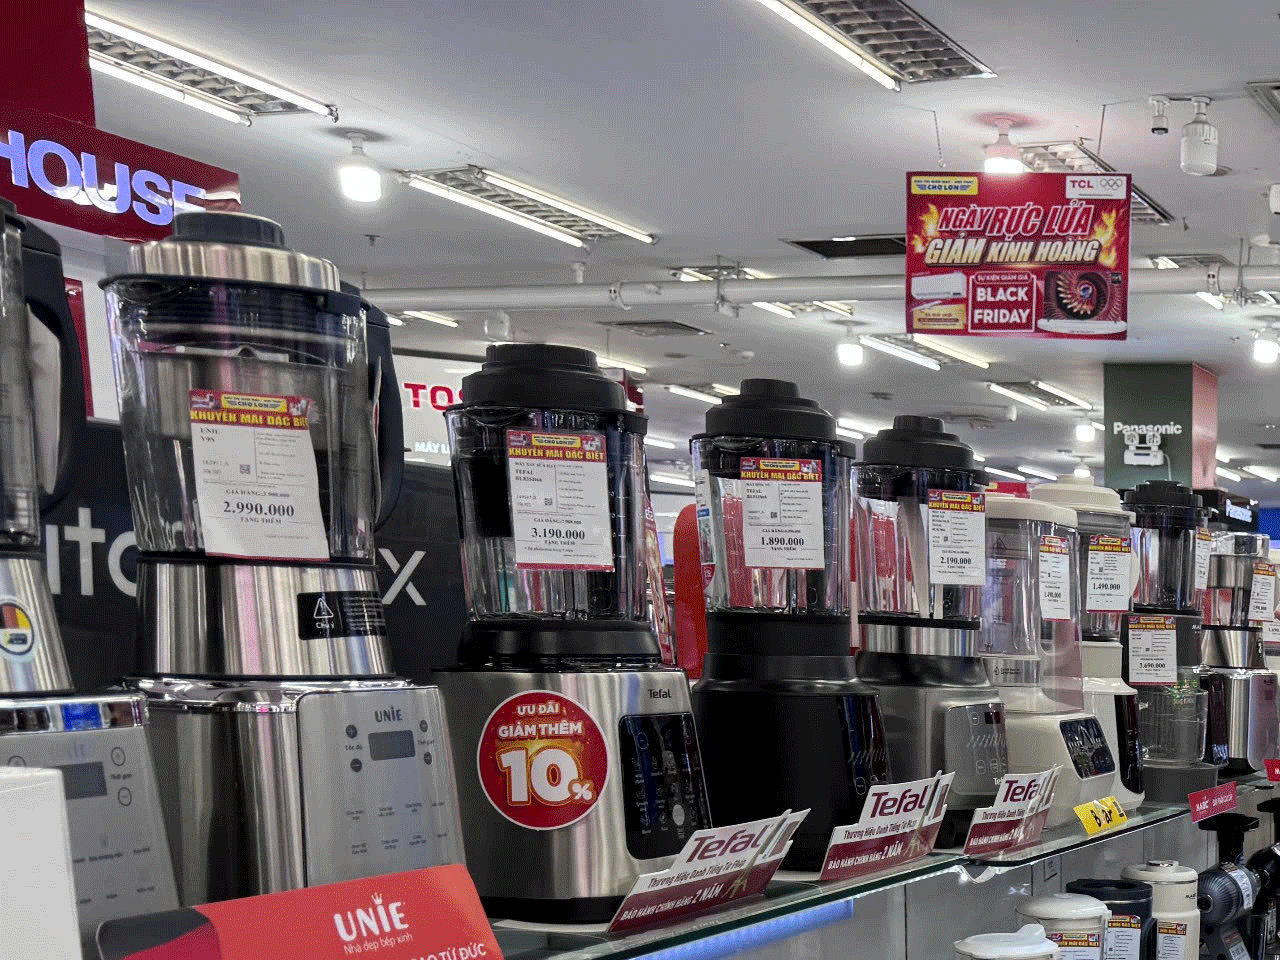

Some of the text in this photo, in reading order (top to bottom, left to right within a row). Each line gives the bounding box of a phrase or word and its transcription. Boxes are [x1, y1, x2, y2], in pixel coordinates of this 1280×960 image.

[1070, 180, 1093, 189] TCL
[938, 199, 1095, 241] NGÀY RỰC LỬA
[924, 233, 1101, 265] GIẢM KINH HOÀNG
[976, 287, 1029, 302] BLACK
[973, 309, 1030, 324] FRIDAY
[1113, 421, 1182, 437] Panasonic
[223, 501, 295, 516] 2.990.000
[531, 528, 585, 540] 3.190.000
[761, 537, 804, 547] 1.890.000
[941, 556, 972, 565] 2.190.000
[1093, 582, 1121, 591] 1.490.000
[648, 689, 672, 699] Tefal
[375, 705, 403, 723] UNIE
[517, 701, 560, 716] ƯU ĐÃI
[498, 720, 583, 737] GIẢM THÊM
[870, 785, 928, 818] Tefal
[686, 825, 770, 863] Tefal
[621, 908, 638, 921] BẢO
[638, 904, 656, 918] HÀNH
[692, 890, 701, 904] 2
[701, 882, 724, 902] NĂM
[333, 898, 409, 942] UNIE
[458, 941, 487, 960] ĐỨC
